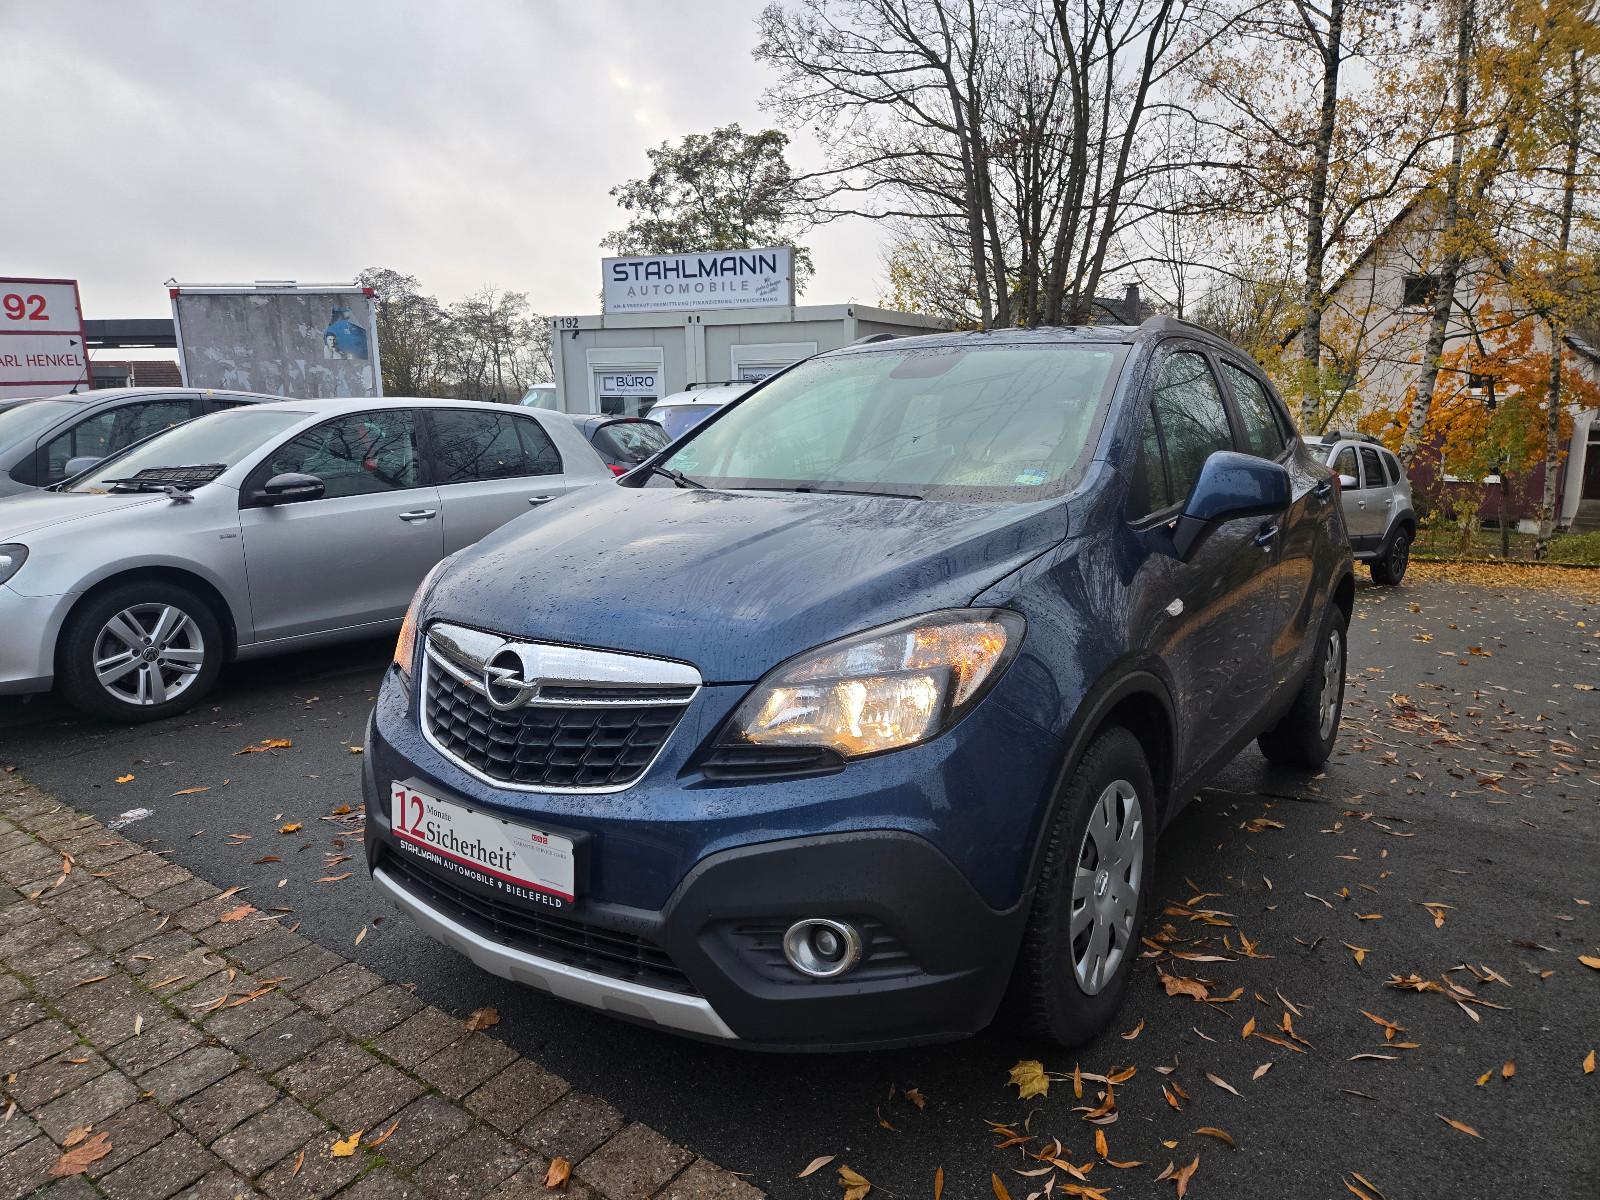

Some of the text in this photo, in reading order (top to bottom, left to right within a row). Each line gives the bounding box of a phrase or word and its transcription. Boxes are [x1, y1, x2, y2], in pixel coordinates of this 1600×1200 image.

[612, 253, 777, 282] STAHLMANN
[626, 280, 749, 297] AUTOMOBILE
[560, 317, 579, 329] 192
[26, 354, 82, 367] HENKEL
[616, 374, 654, 387] BÜRO
[395, 791, 452, 840] 12 Monate
[400, 839, 562, 908] STAHLMANN AUTOMOBILE BIELEFELD
